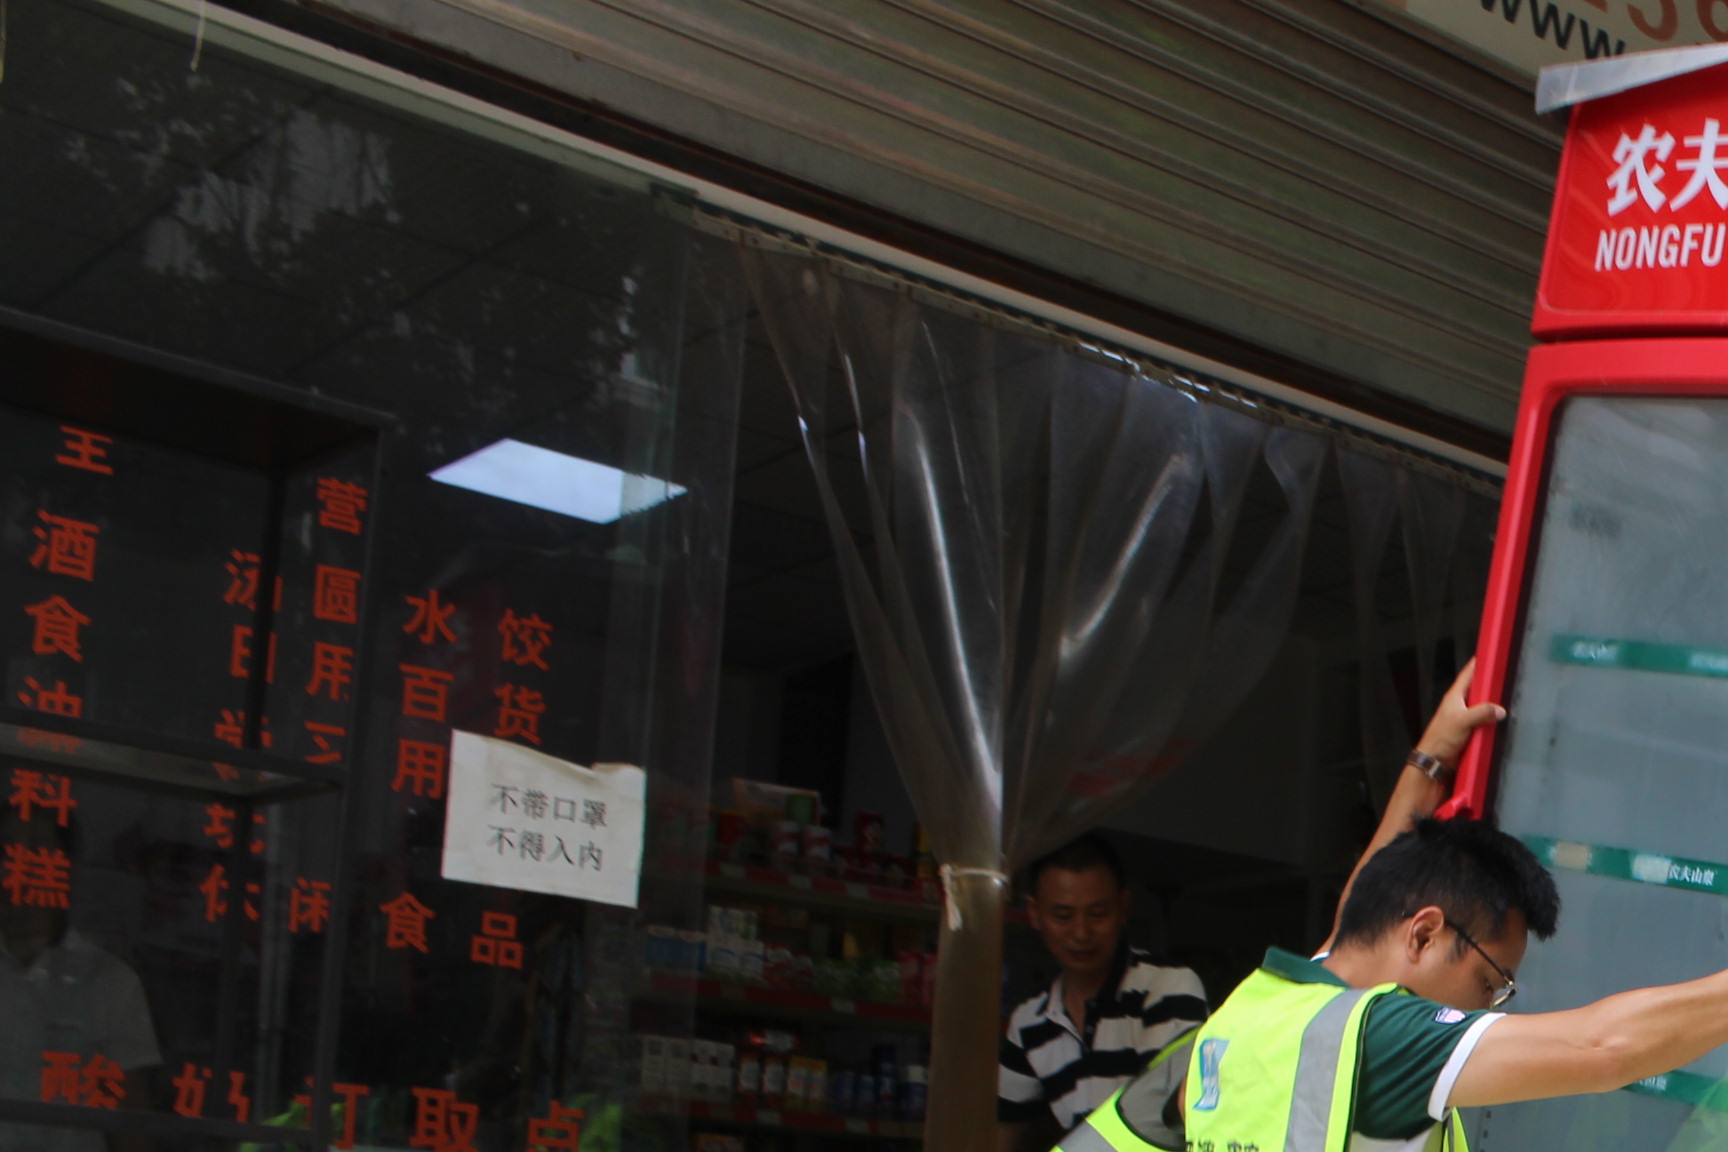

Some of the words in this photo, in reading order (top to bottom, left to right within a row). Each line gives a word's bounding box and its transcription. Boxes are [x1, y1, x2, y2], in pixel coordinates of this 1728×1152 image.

[1594, 222, 1727, 272] NONGFU
[490, 782, 607, 830] 不带口罩
[486, 823, 603, 873] 不得入内
